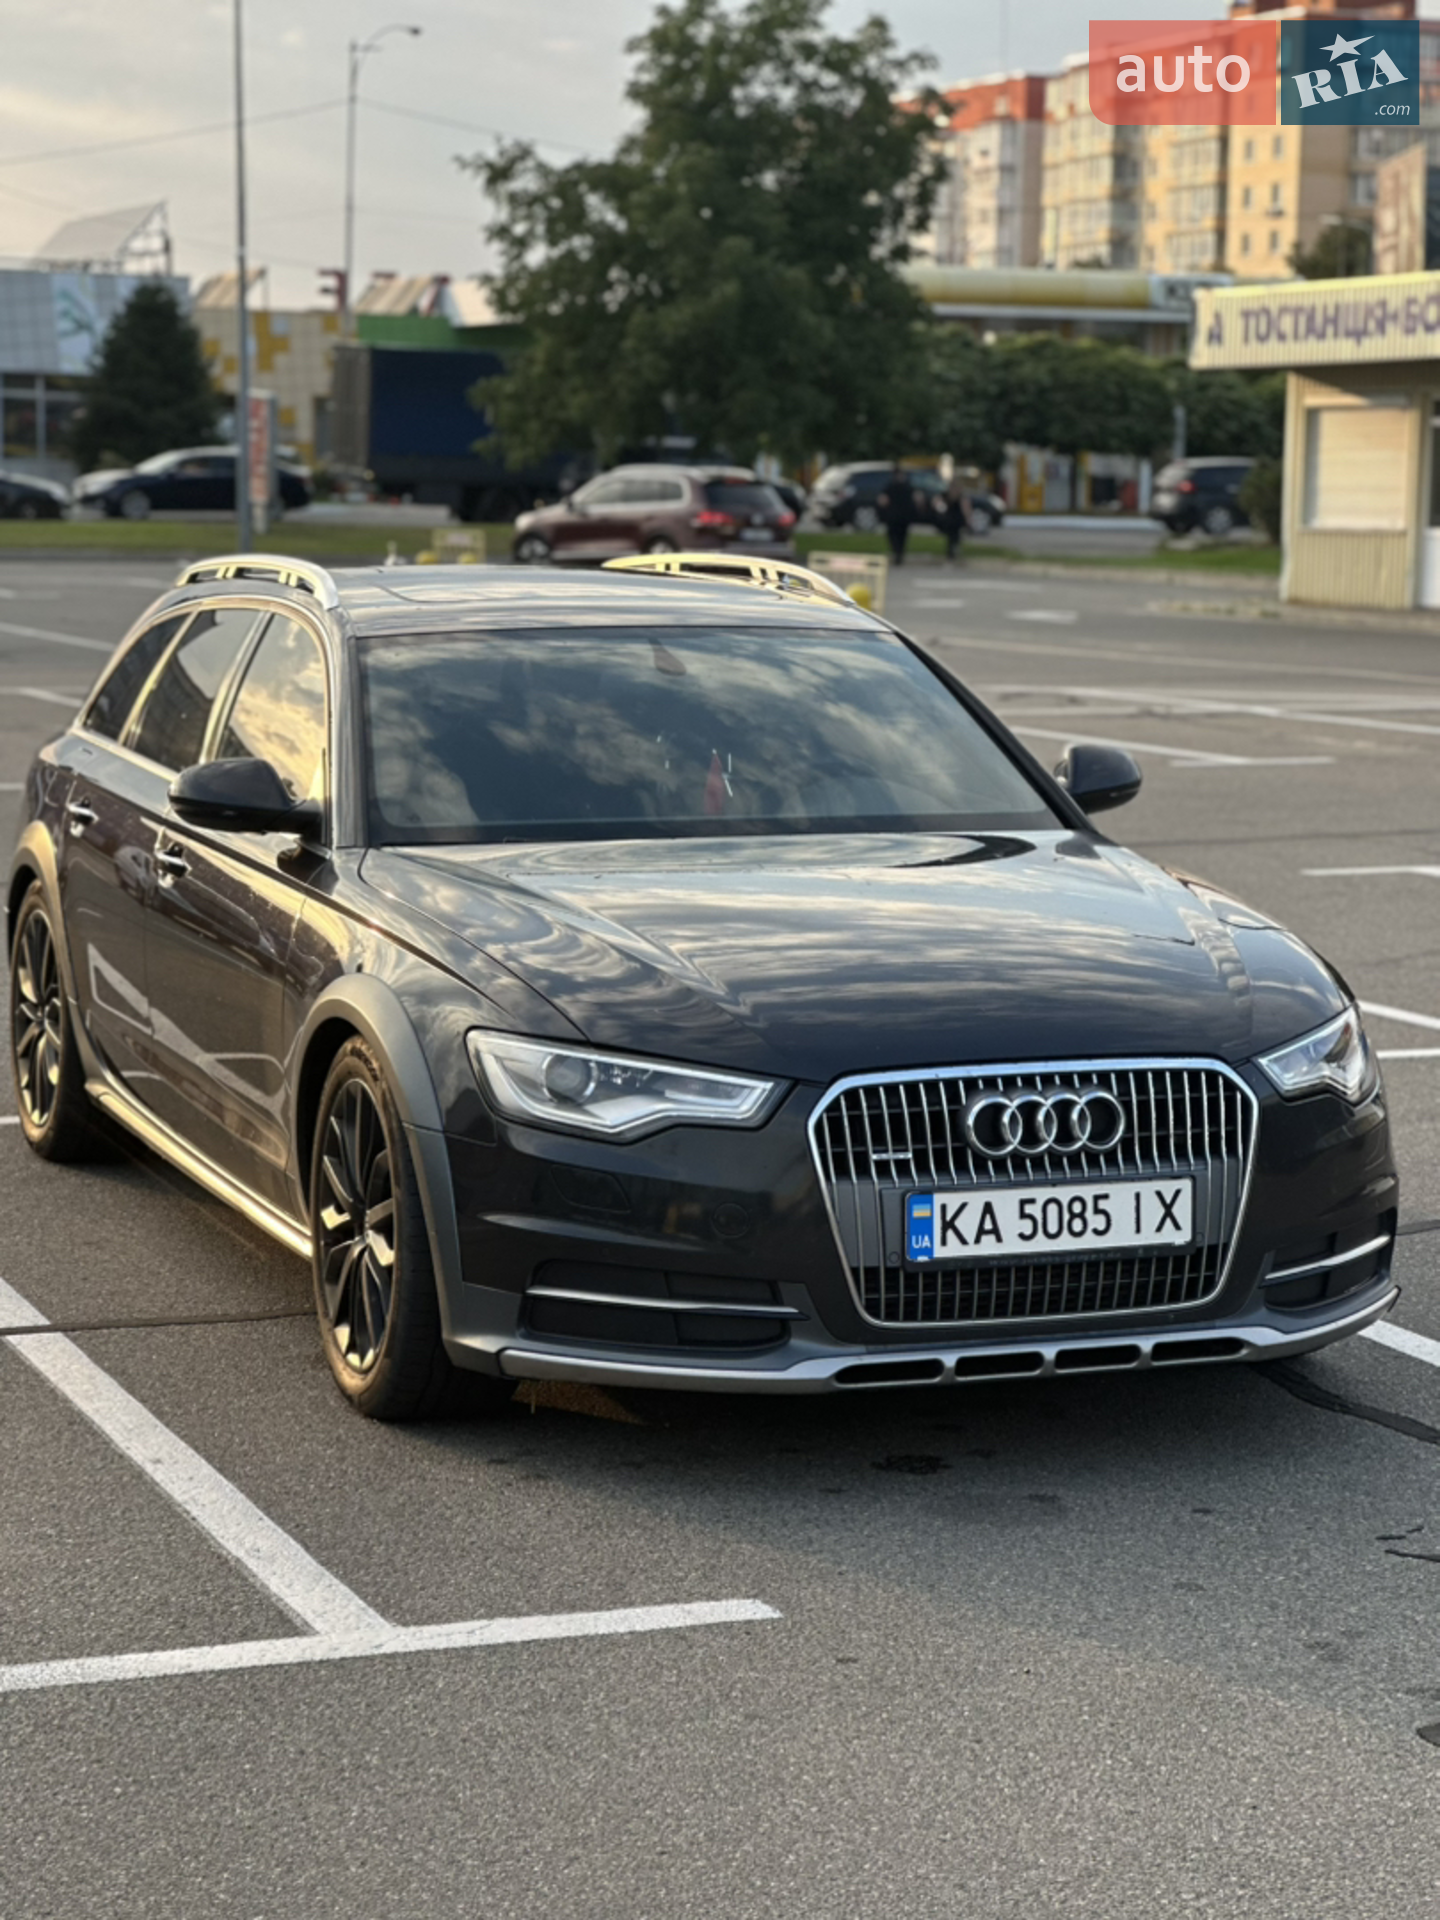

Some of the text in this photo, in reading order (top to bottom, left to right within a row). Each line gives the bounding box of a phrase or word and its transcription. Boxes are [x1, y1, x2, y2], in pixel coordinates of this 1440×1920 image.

[940, 1188, 1183, 1247] KA 5085 IX
[911, 1235, 931, 1248] UA
